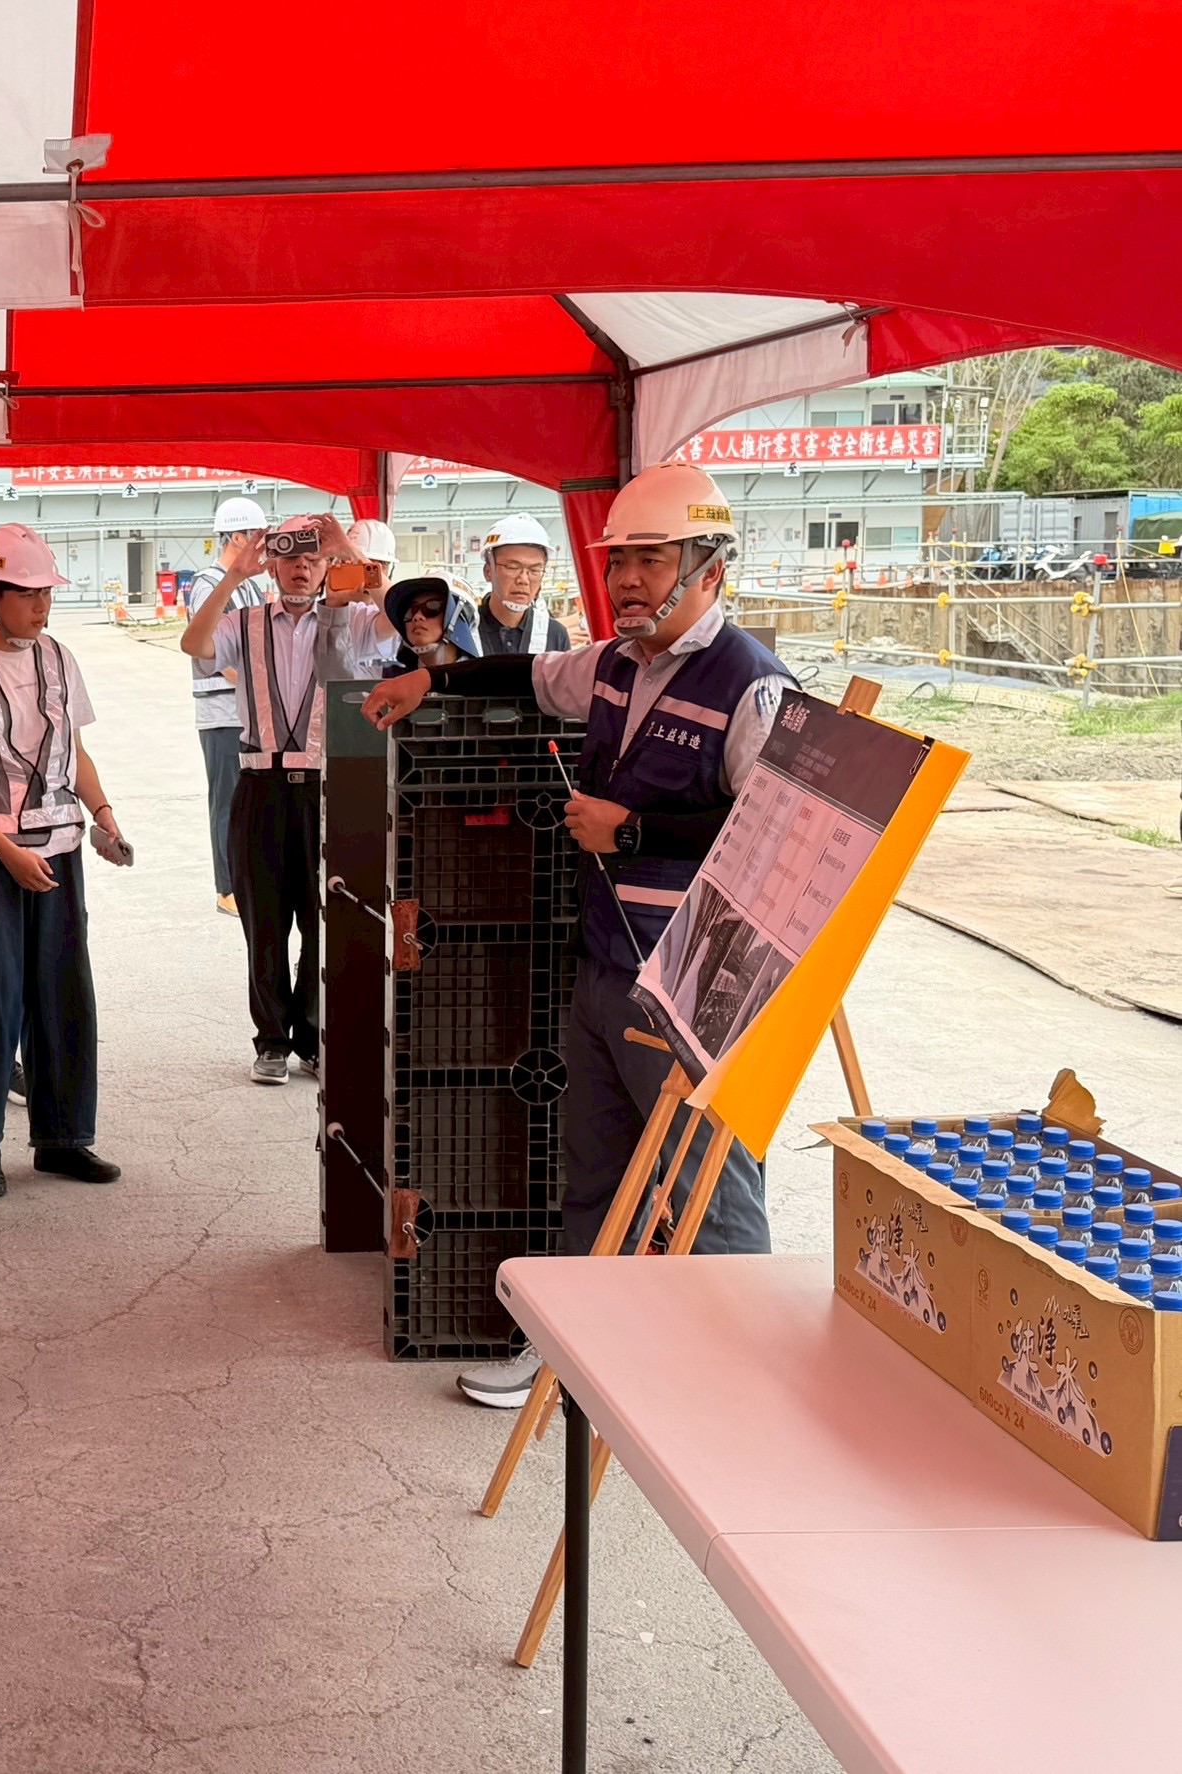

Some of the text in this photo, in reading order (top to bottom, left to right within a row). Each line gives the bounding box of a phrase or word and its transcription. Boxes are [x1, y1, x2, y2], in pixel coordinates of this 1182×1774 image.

[5, 487, 17, 499] 安
[124, 484, 137, 496] 全
[245, 480, 255, 492] 第
[908, 459, 919, 471] 上
[1014, 1411, 1025, 1431] 24
